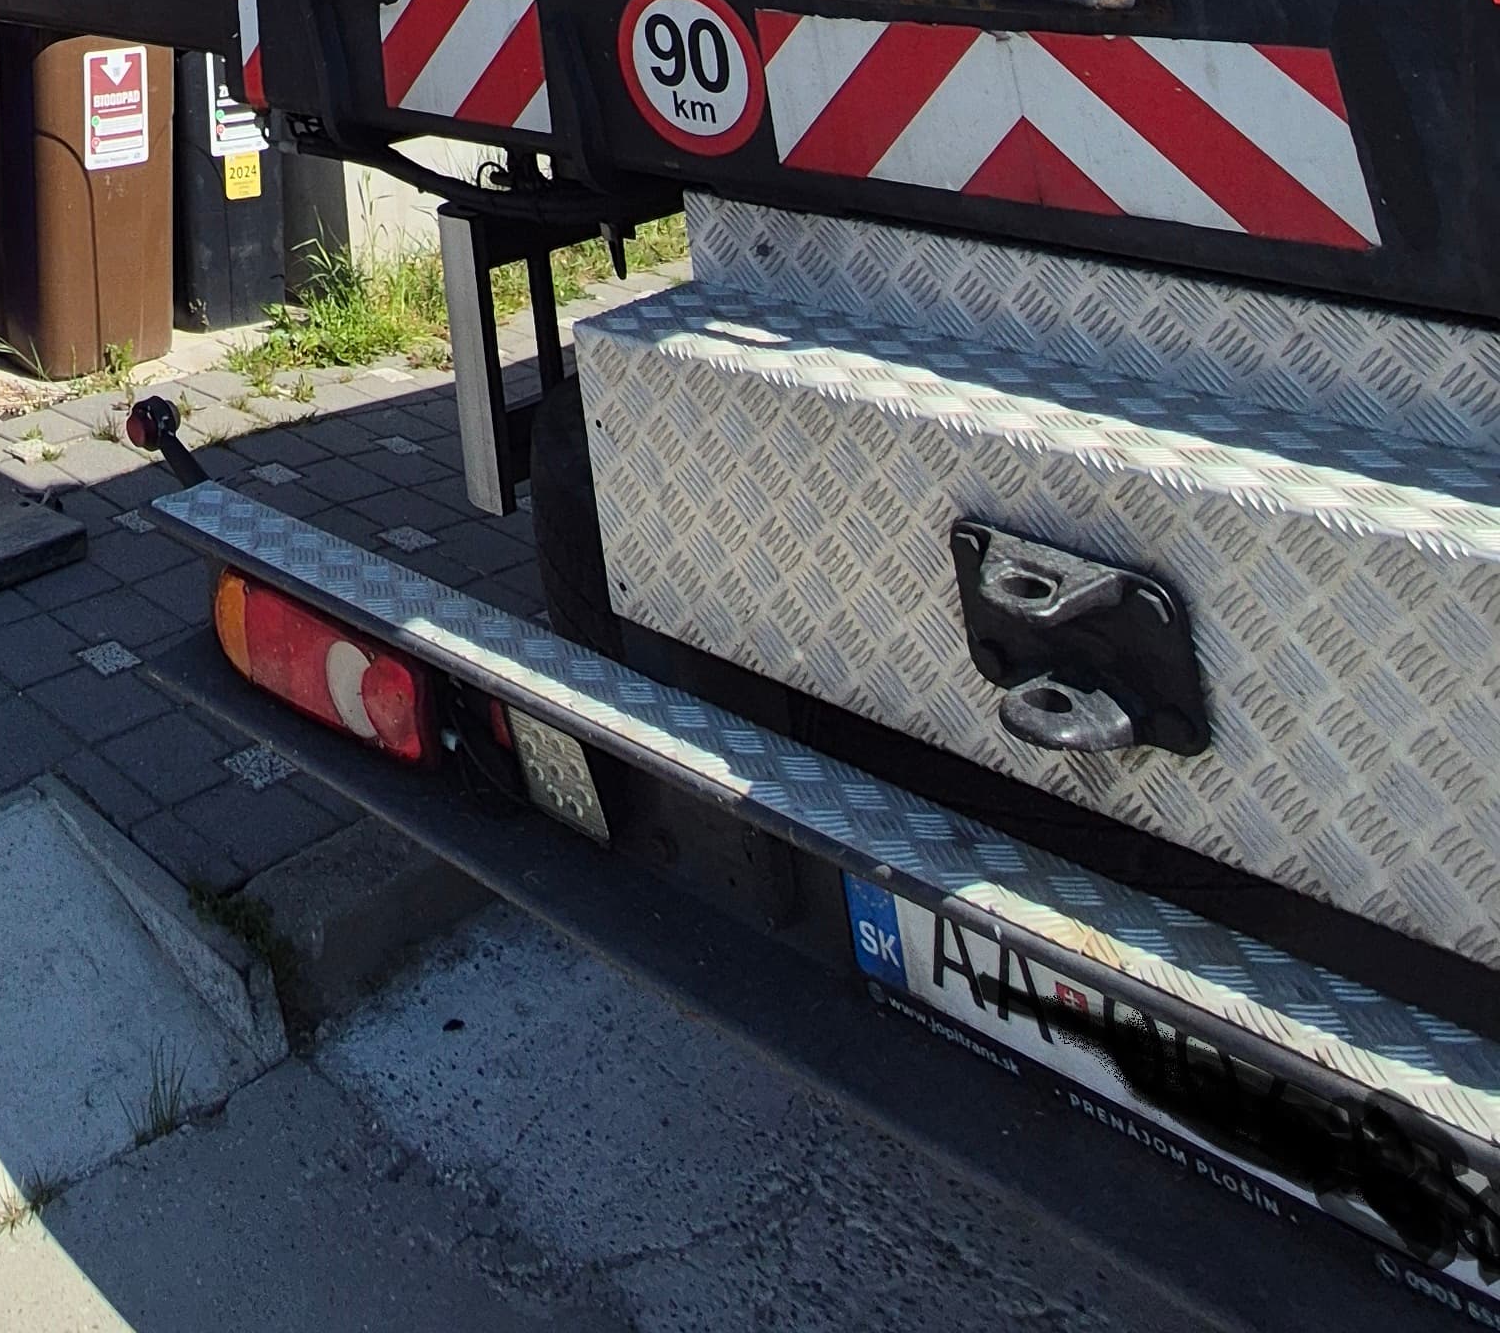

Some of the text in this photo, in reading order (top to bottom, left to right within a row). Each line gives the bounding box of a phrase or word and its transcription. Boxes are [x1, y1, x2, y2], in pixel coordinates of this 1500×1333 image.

[644, 13, 730, 94] 90
[93, 90, 140, 108] BIOODPAD
[672, 90, 717, 124] km
[229, 164, 257, 180] 2024
[858, 919, 900, 968] SK
[1068, 1091, 1188, 1167] PRENÁJOM
[1196, 1157, 1281, 1217] PLOŠÍN
